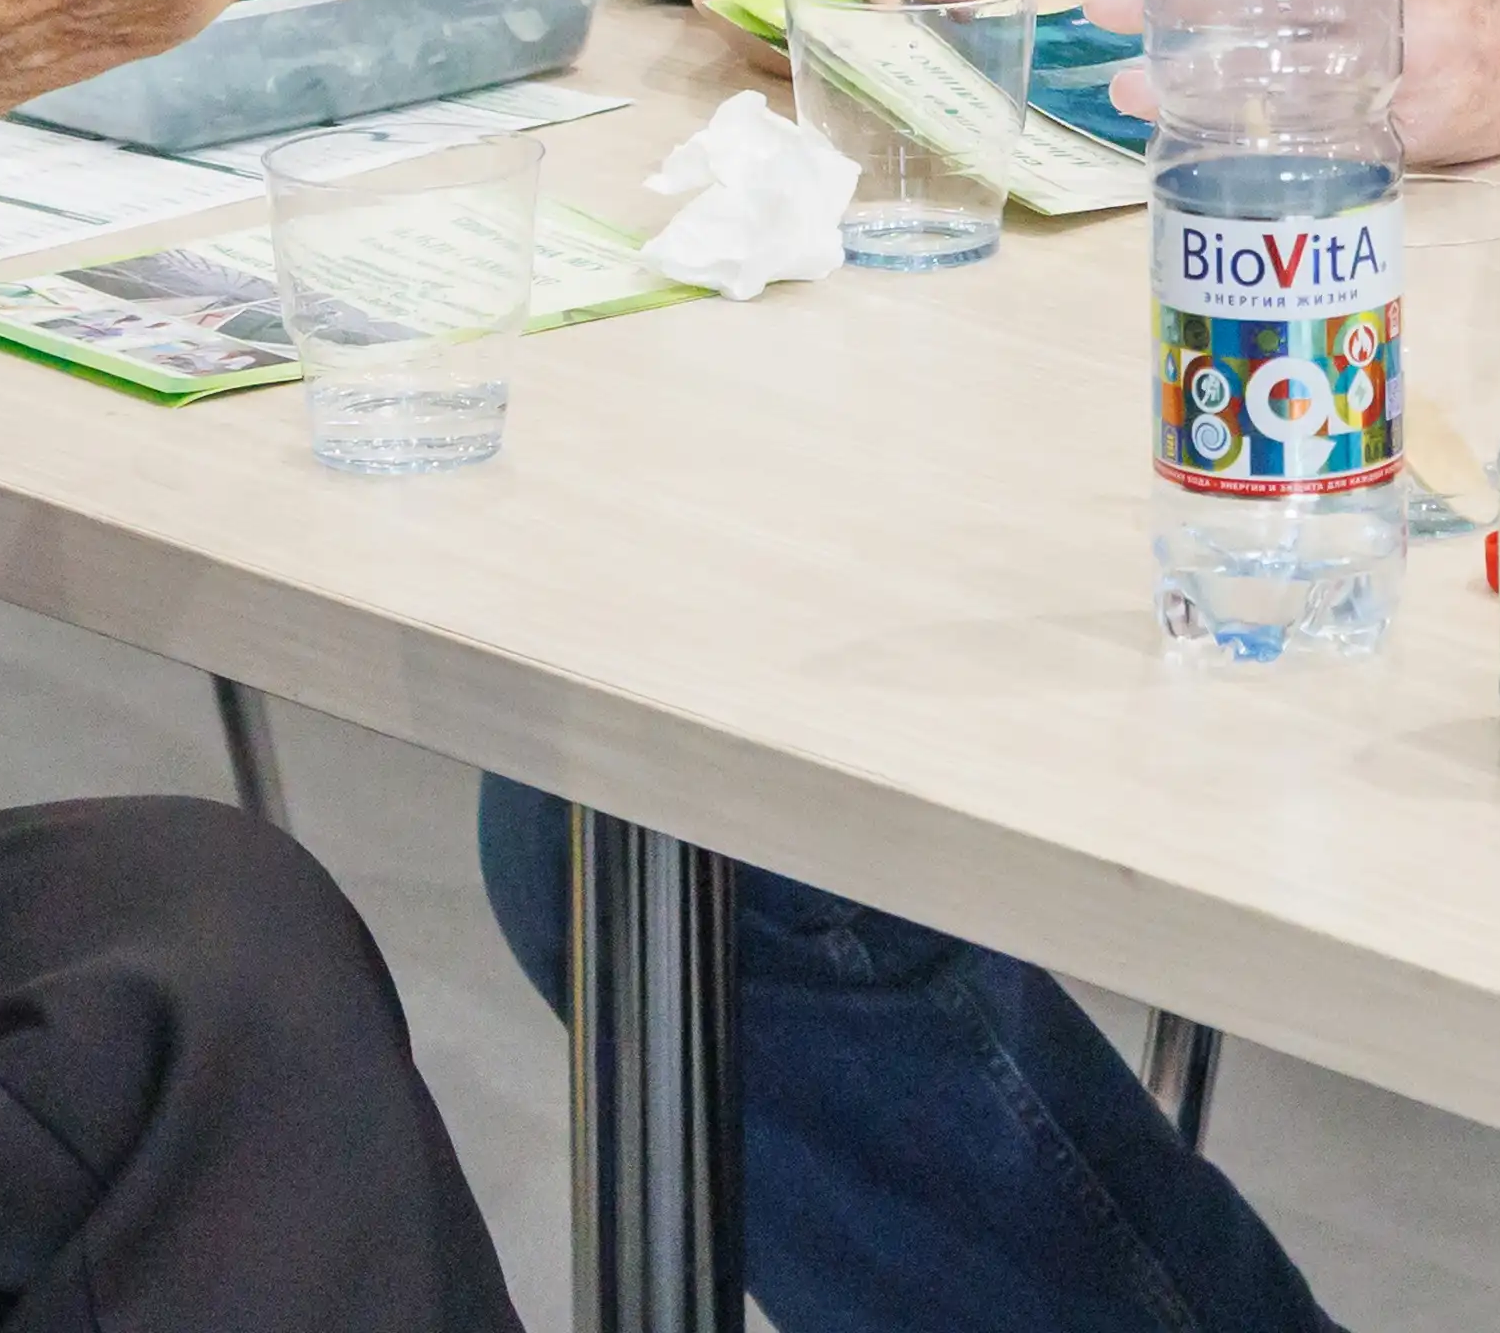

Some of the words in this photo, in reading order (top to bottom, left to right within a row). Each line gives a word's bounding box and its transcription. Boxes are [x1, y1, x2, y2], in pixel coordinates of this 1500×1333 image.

[1183, 226, 1380, 288] BioVitA
[1204, 291, 1287, 308] ЭНЕРГИЯ
[1297, 289, 1359, 306] ЖИЗНИ
